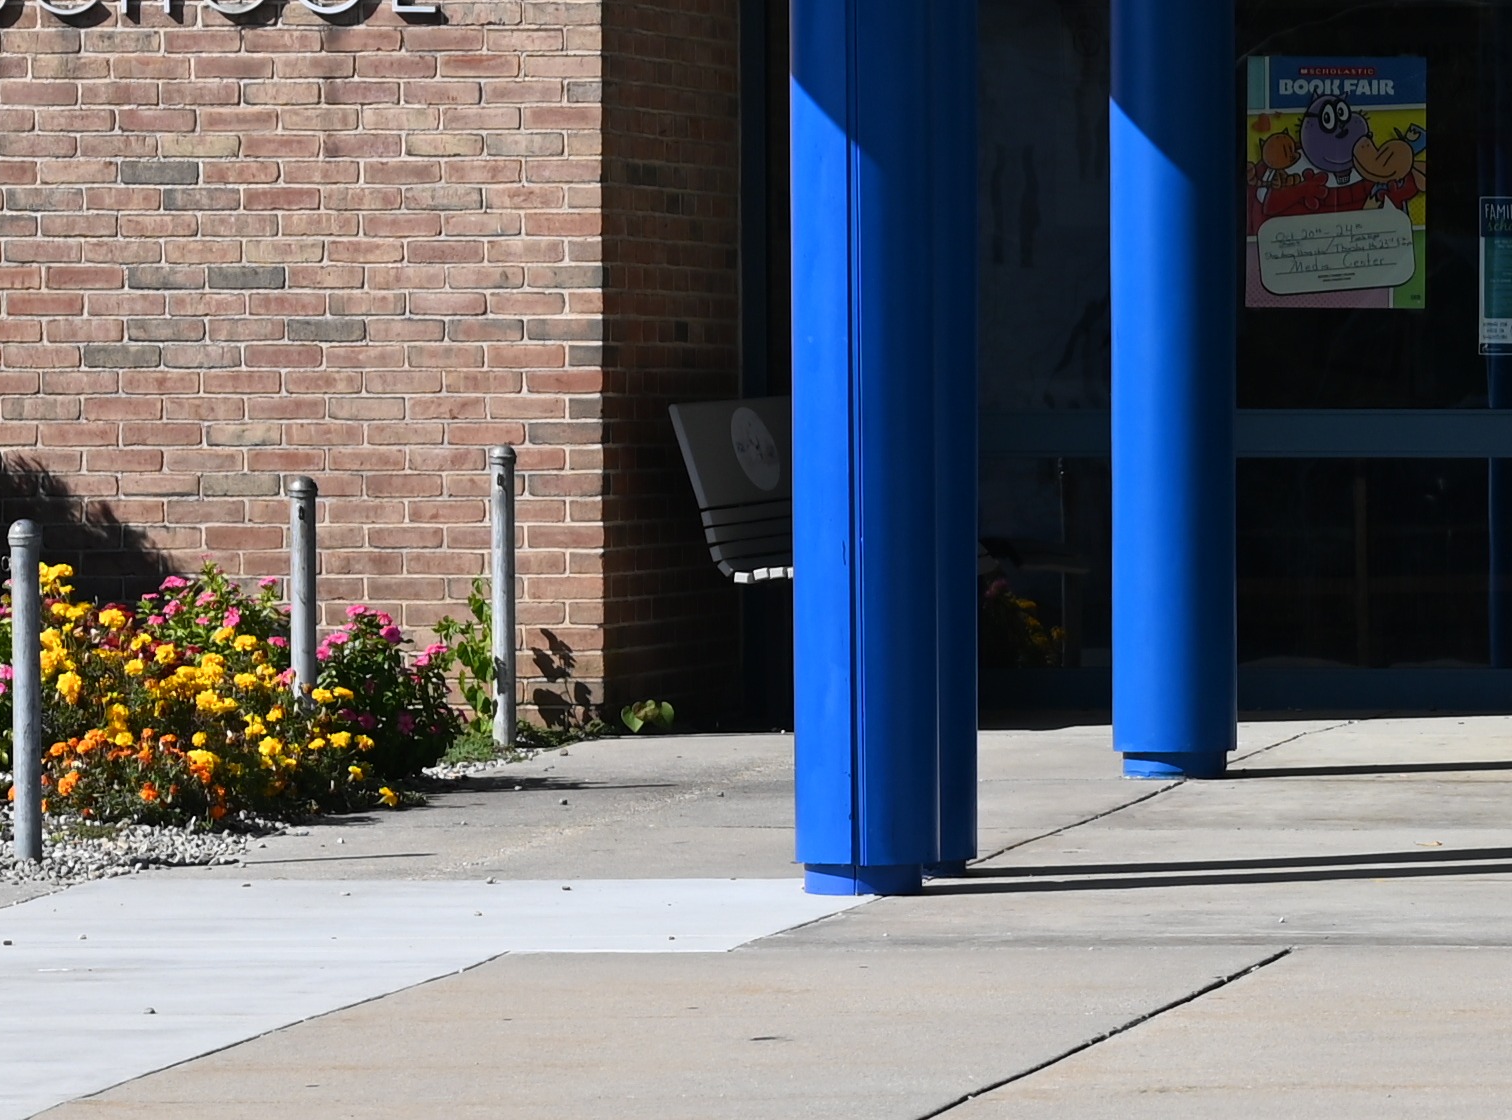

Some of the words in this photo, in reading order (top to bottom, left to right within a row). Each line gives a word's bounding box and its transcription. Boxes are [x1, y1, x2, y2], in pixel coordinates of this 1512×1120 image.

[1279, 79, 1341, 95] BOOK
[1344, 79, 1395, 95] FAIR
[1343, 252, 1384, 267] Center
